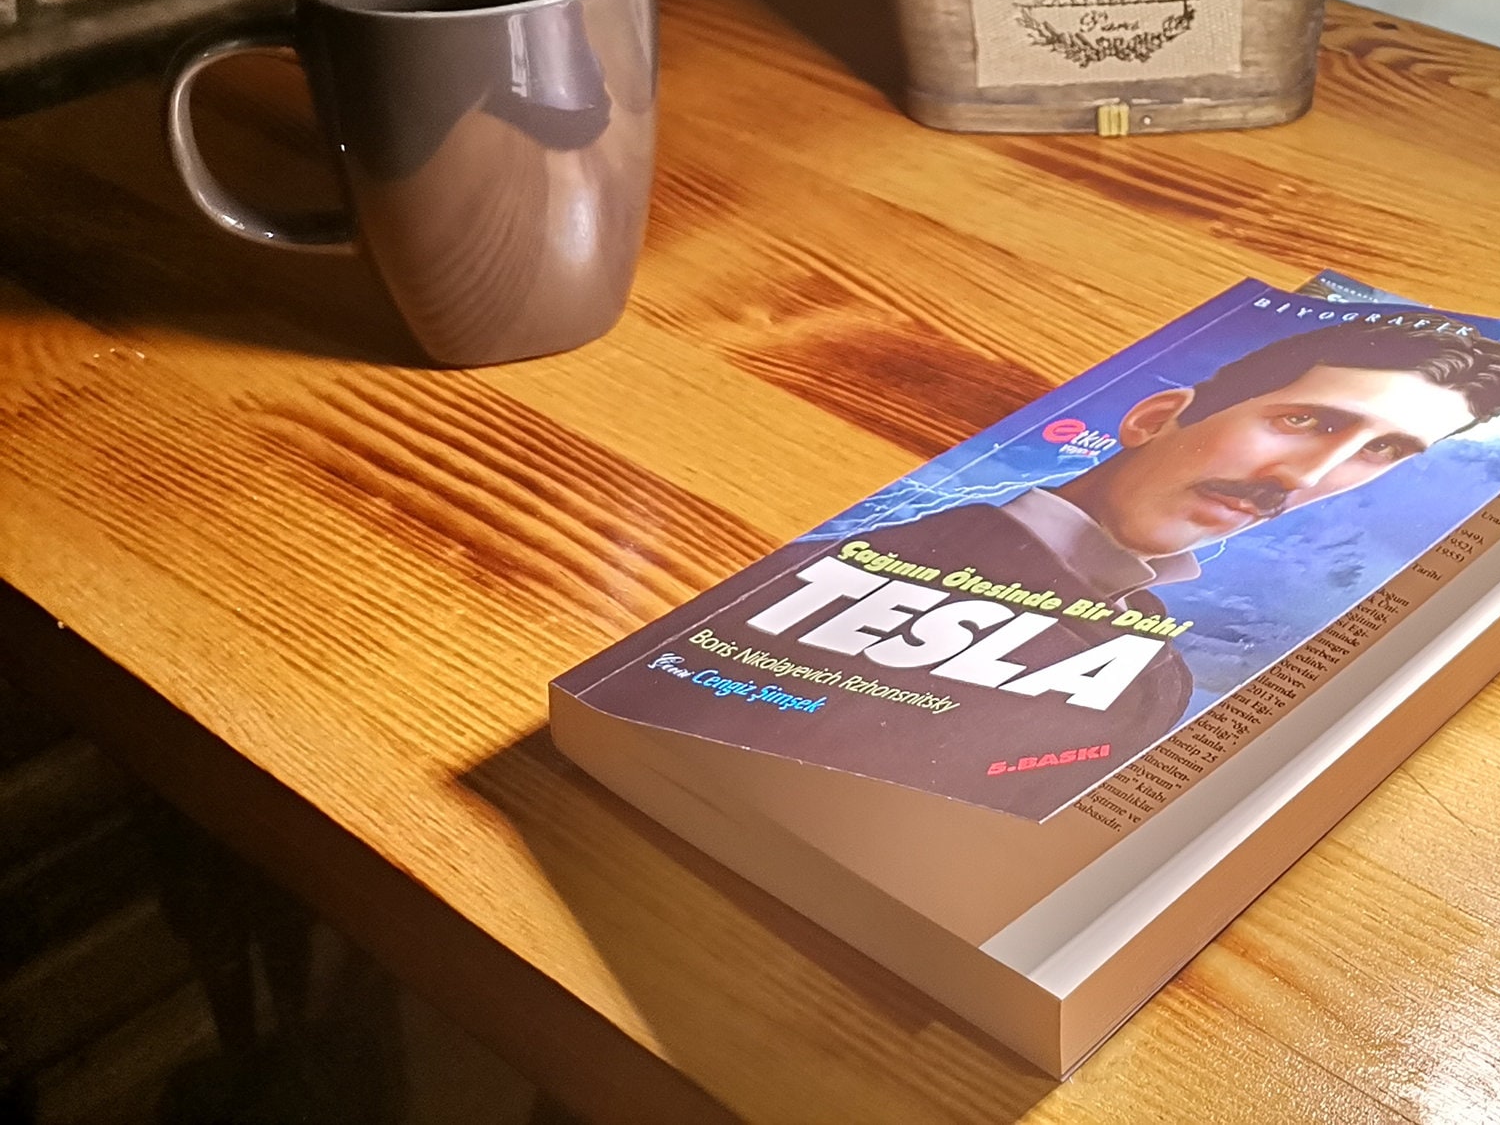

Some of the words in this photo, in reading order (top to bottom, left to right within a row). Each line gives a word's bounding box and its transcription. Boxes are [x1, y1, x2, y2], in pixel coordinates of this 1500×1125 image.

[837, 540, 941, 582] Çağının
[942, 567, 1063, 611] Ötesinde
[1062, 598, 1114, 621] Bir
[1111, 609, 1194, 638] Dâhi
[689, 628, 739, 657] Boris
[733, 648, 843, 686] Nikolayevich
[839, 675, 960, 714] Rzhonsnitsky
[746, 555, 1167, 711] TESLA
[692, 669, 757, 697] Cengiz
[747, 684, 827, 713] Şimşek
[1128, 812, 1142, 824] ve
